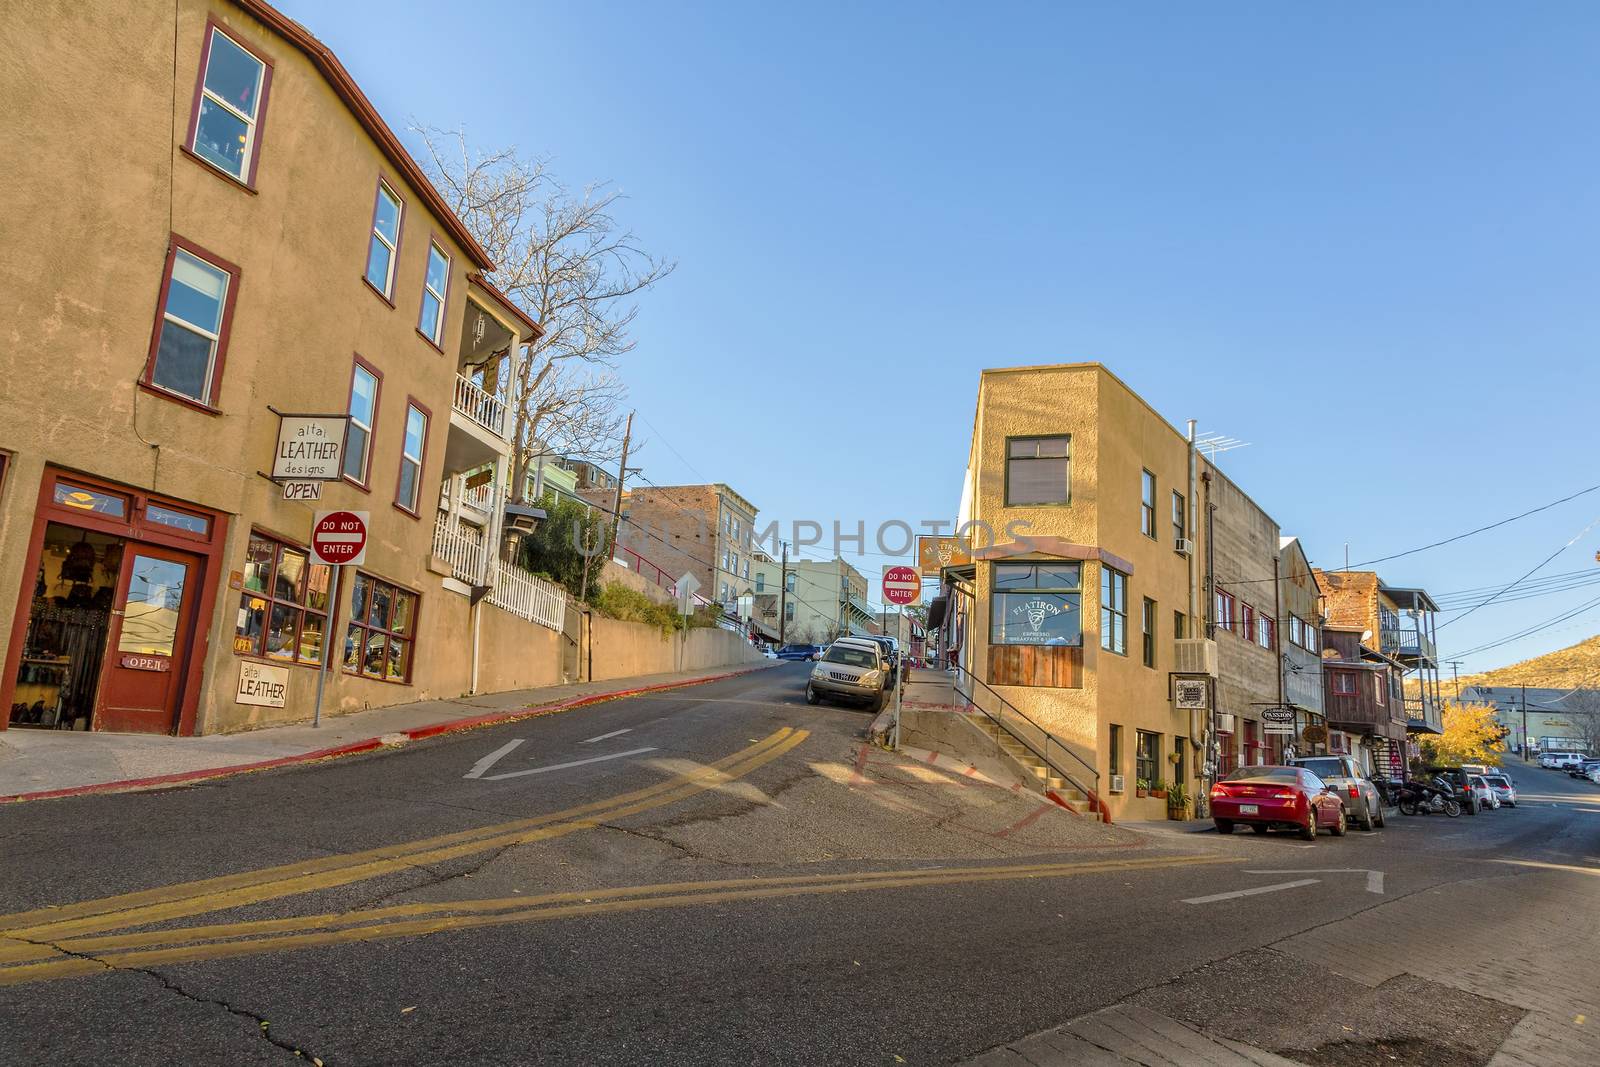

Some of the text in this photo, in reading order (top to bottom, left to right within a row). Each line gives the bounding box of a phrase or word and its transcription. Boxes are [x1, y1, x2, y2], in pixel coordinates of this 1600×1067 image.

[298, 423, 327, 438] altai
[280, 441, 338, 460] LEATHER
[285, 461, 326, 477] designs
[285, 482, 321, 499] OPEN
[322, 521, 361, 530] DO NOT
[322, 544, 354, 554] ENTER
[901, 573, 916, 581] NOT
[890, 590, 913, 598] ENTER
[1012, 600, 1061, 616] FLATIRON
[234, 638, 252, 652] OPEN
[240, 678, 284, 700] LEATHER
